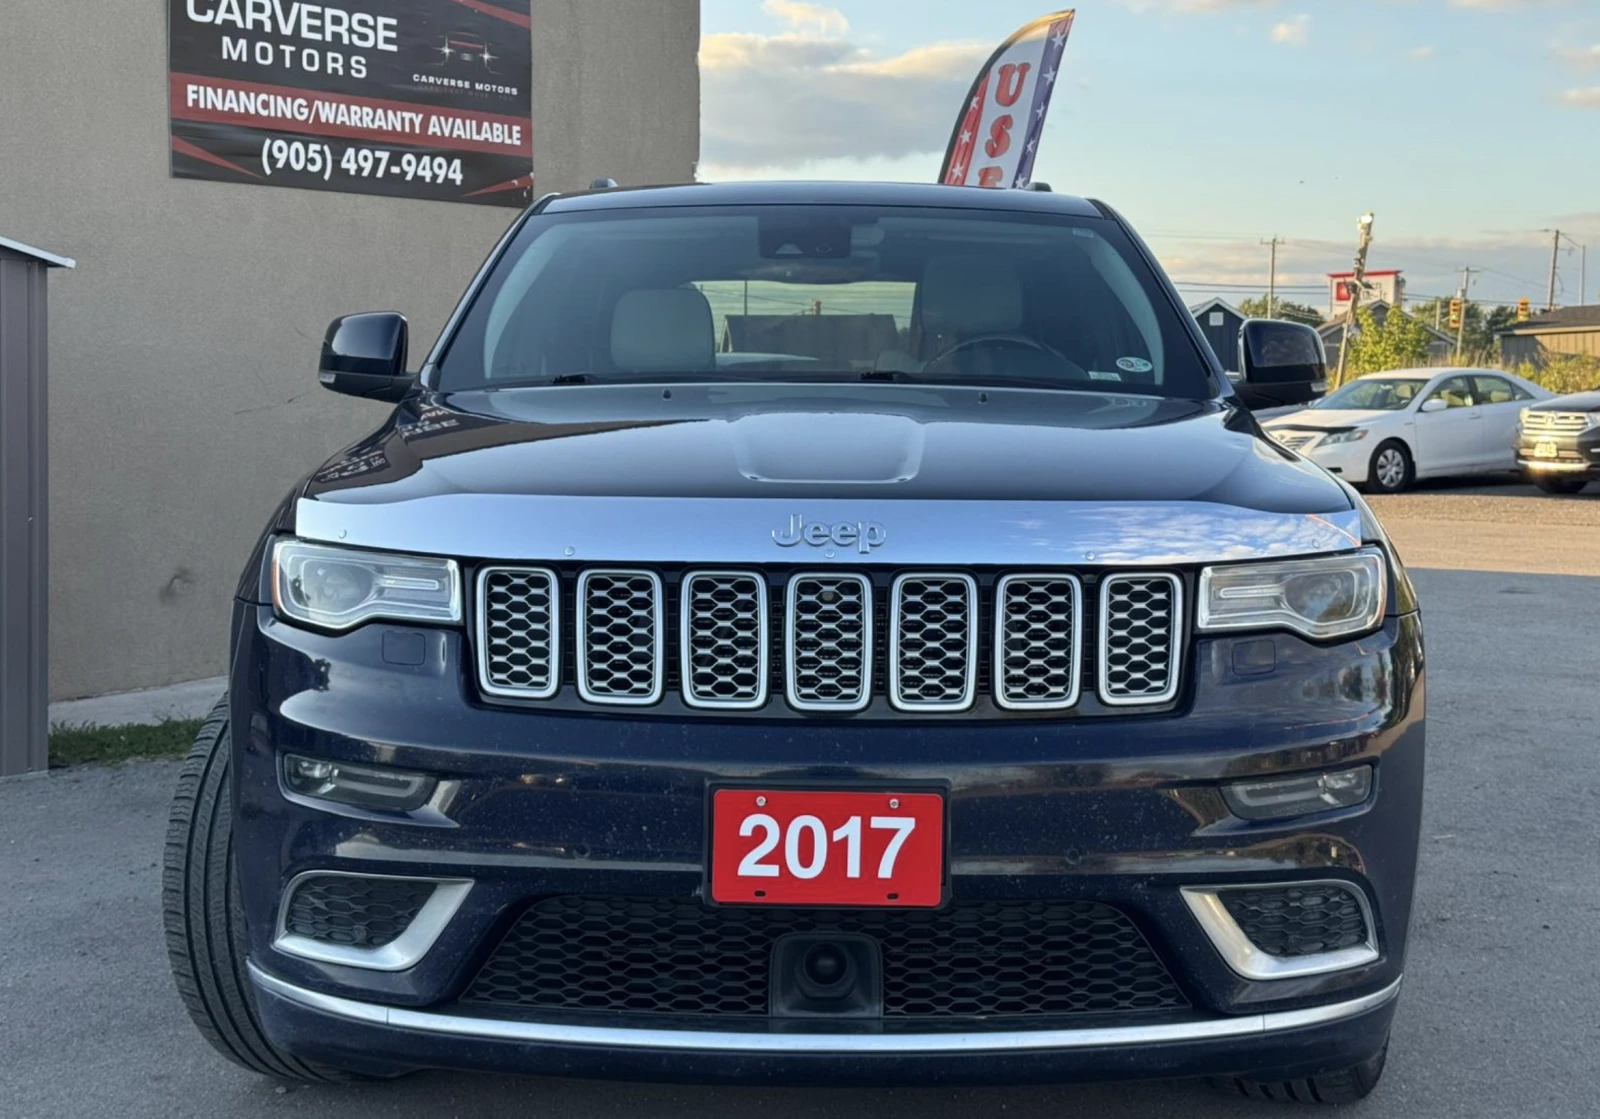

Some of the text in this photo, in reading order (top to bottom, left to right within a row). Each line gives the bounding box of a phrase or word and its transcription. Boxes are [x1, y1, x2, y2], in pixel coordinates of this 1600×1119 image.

[186, 0, 398, 52] CARVERSE
[221, 36, 367, 79] MOTORS
[412, 73, 471, 89] CARVERSE
[474, 81, 518, 96] MOTORS
[186, 84, 424, 134] FINANCING/WARRANTY
[427, 115, 522, 146] AVAILABLE
[261, 138, 464, 186] (905) 497-9494
[771, 514, 887, 554] Jeep
[737, 813, 916, 879] 2017
